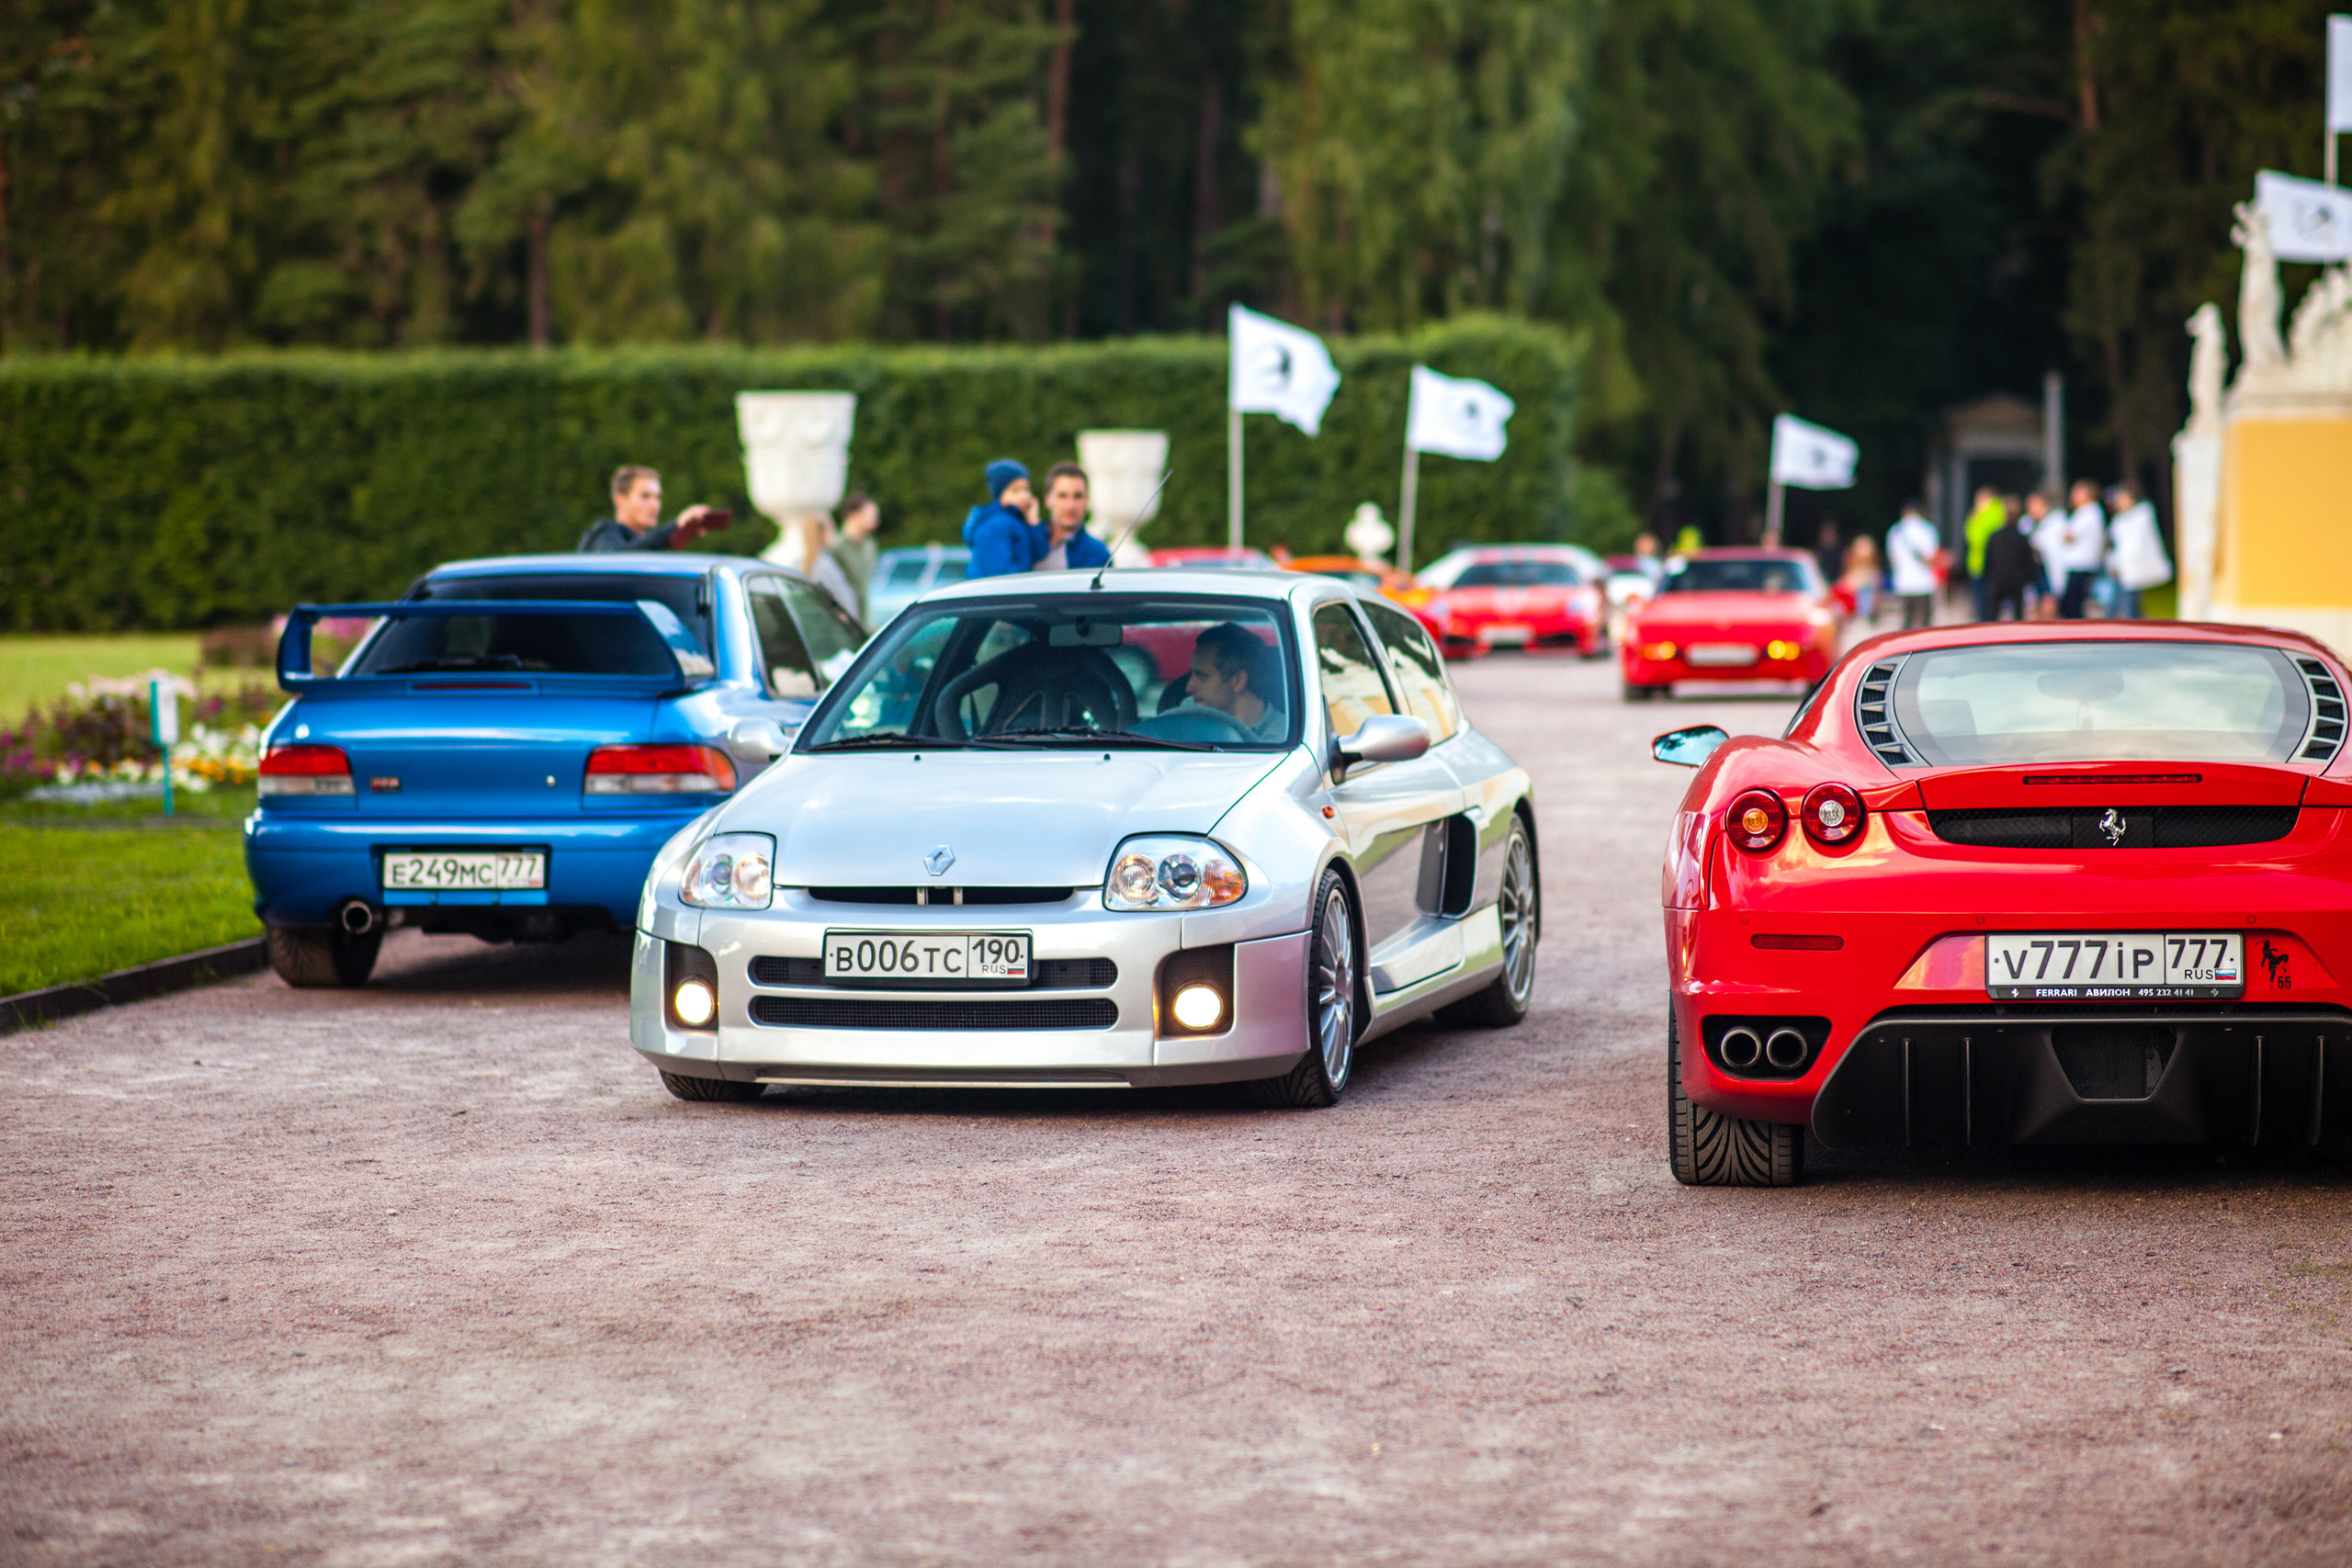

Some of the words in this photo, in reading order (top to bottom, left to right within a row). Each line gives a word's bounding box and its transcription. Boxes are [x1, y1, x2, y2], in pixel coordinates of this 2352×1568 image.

[499, 857, 537, 876] 777
[836, 940, 962, 972] В006ТС
[972, 939, 1020, 964] 190
[2167, 939, 2228, 969] 777
[982, 965, 1005, 974] RUS
[2185, 970, 2214, 980] RUS
[2278, 976, 2291, 989] 55
[2036, 988, 2077, 997] FERRARI
[2086, 988, 2131, 997] АВИЛОН
[2138, 988, 2154, 997] 495
[2156, 988, 2171, 997] 232
[2174, 988, 2183, 997] 41
[2185, 988, 2194, 997] 41
